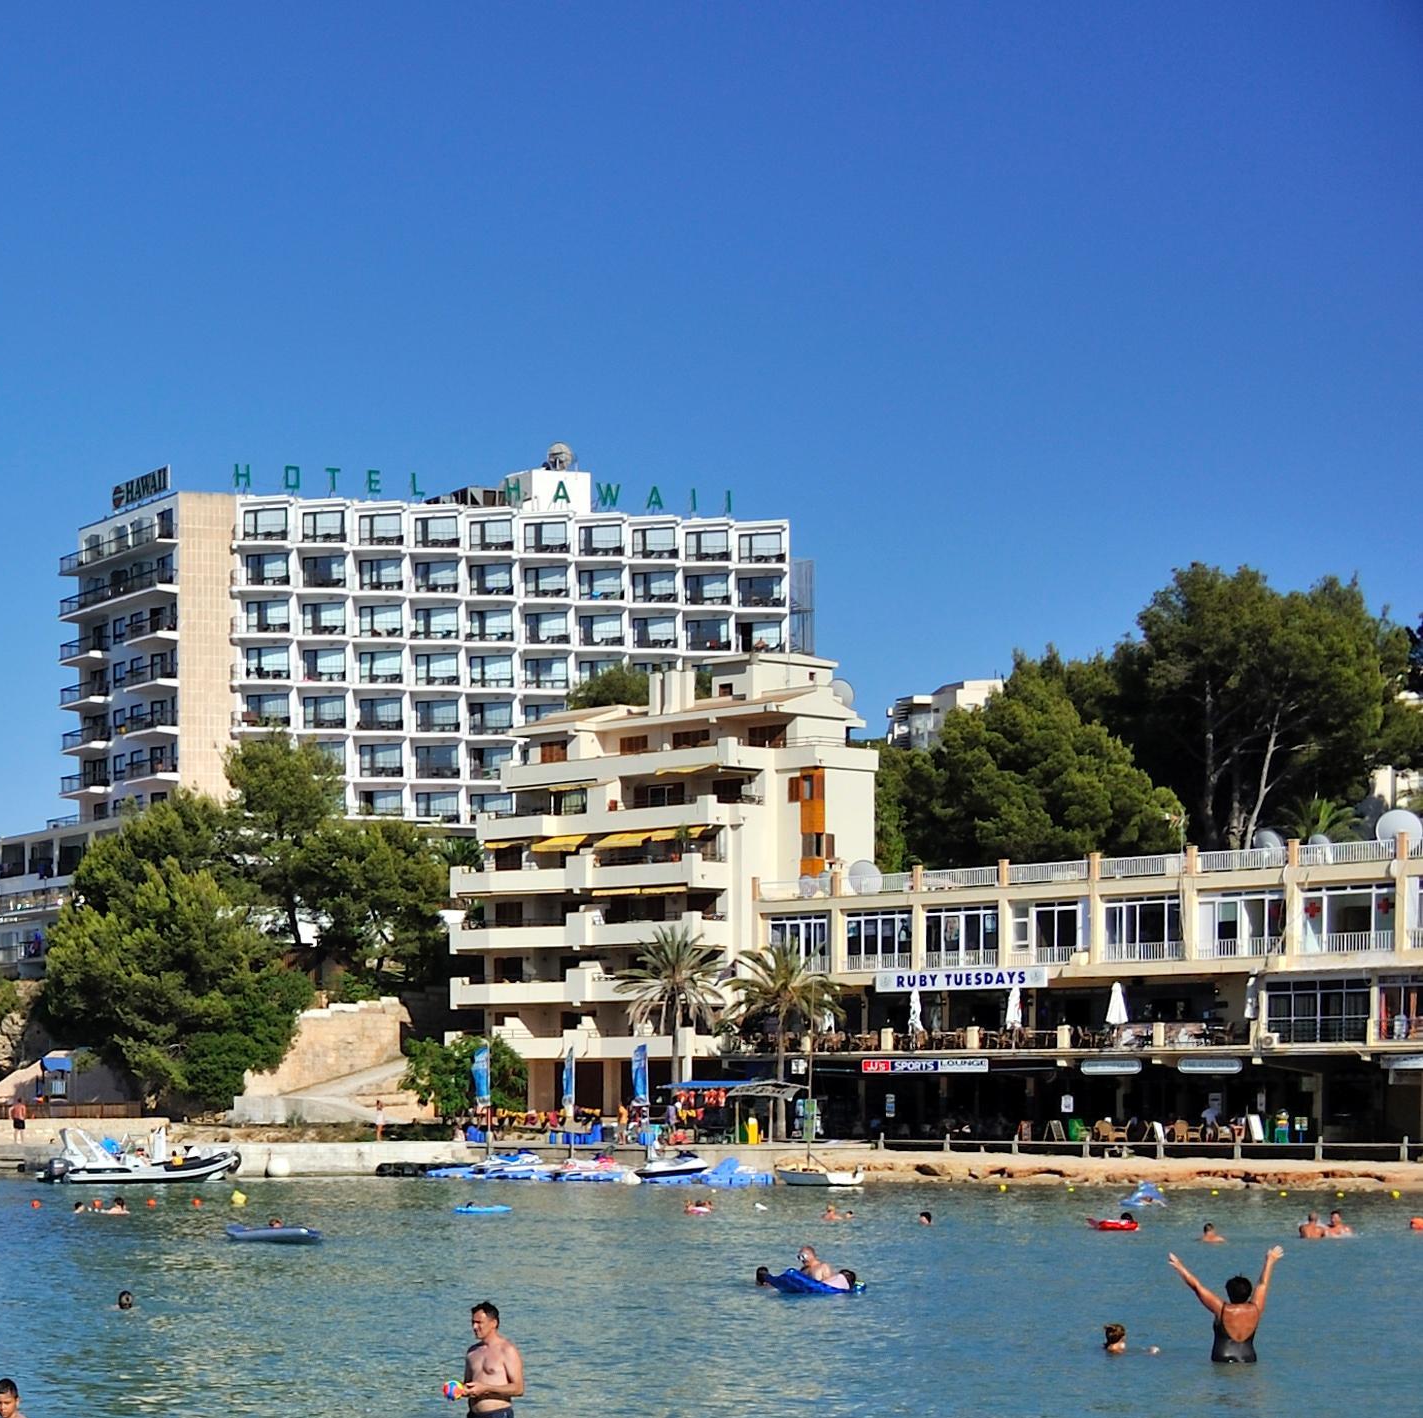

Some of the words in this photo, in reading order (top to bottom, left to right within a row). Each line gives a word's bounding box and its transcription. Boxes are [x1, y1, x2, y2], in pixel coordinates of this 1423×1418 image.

[234, 464, 425, 497] HOTEL
[505, 477, 732, 514] HAWAII
[896, 974, 938, 988] RUBY
[944, 971, 1026, 986] TUESDAYS
[894, 1061, 935, 1071] SPORTS
